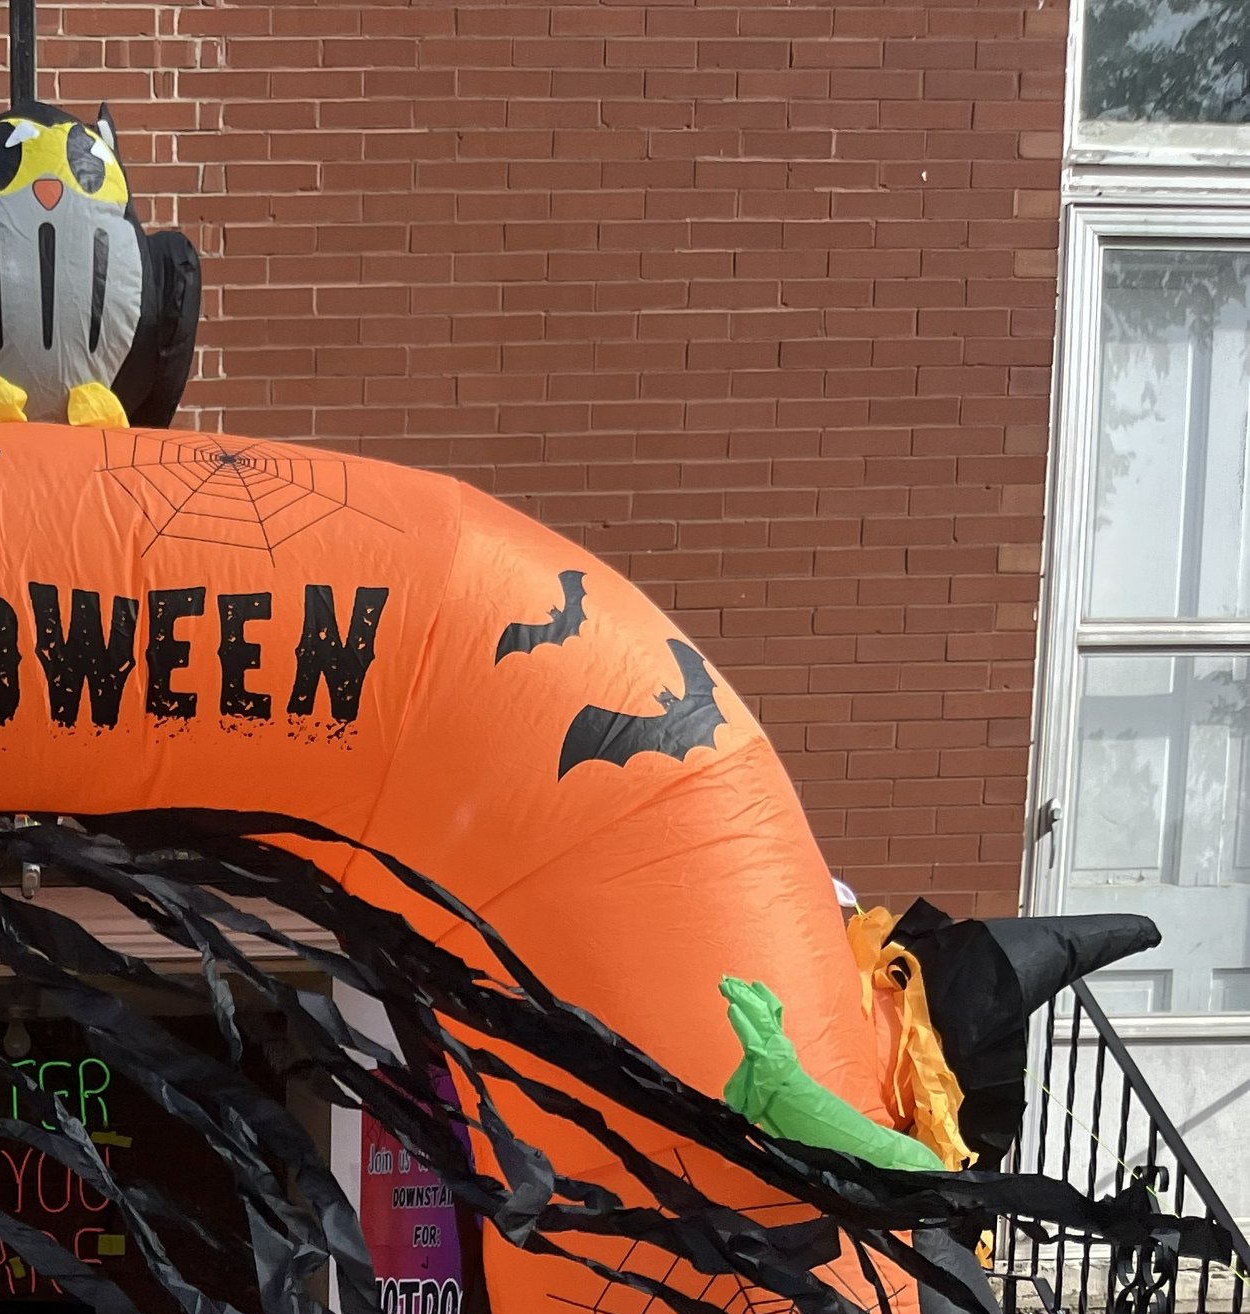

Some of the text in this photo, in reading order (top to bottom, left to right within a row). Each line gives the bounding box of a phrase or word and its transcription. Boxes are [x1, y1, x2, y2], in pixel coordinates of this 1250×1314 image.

[368, 1144, 393, 1175] Join
[1, 1146, 110, 1213] YOU
[413, 1224, 442, 1248] FOR:
